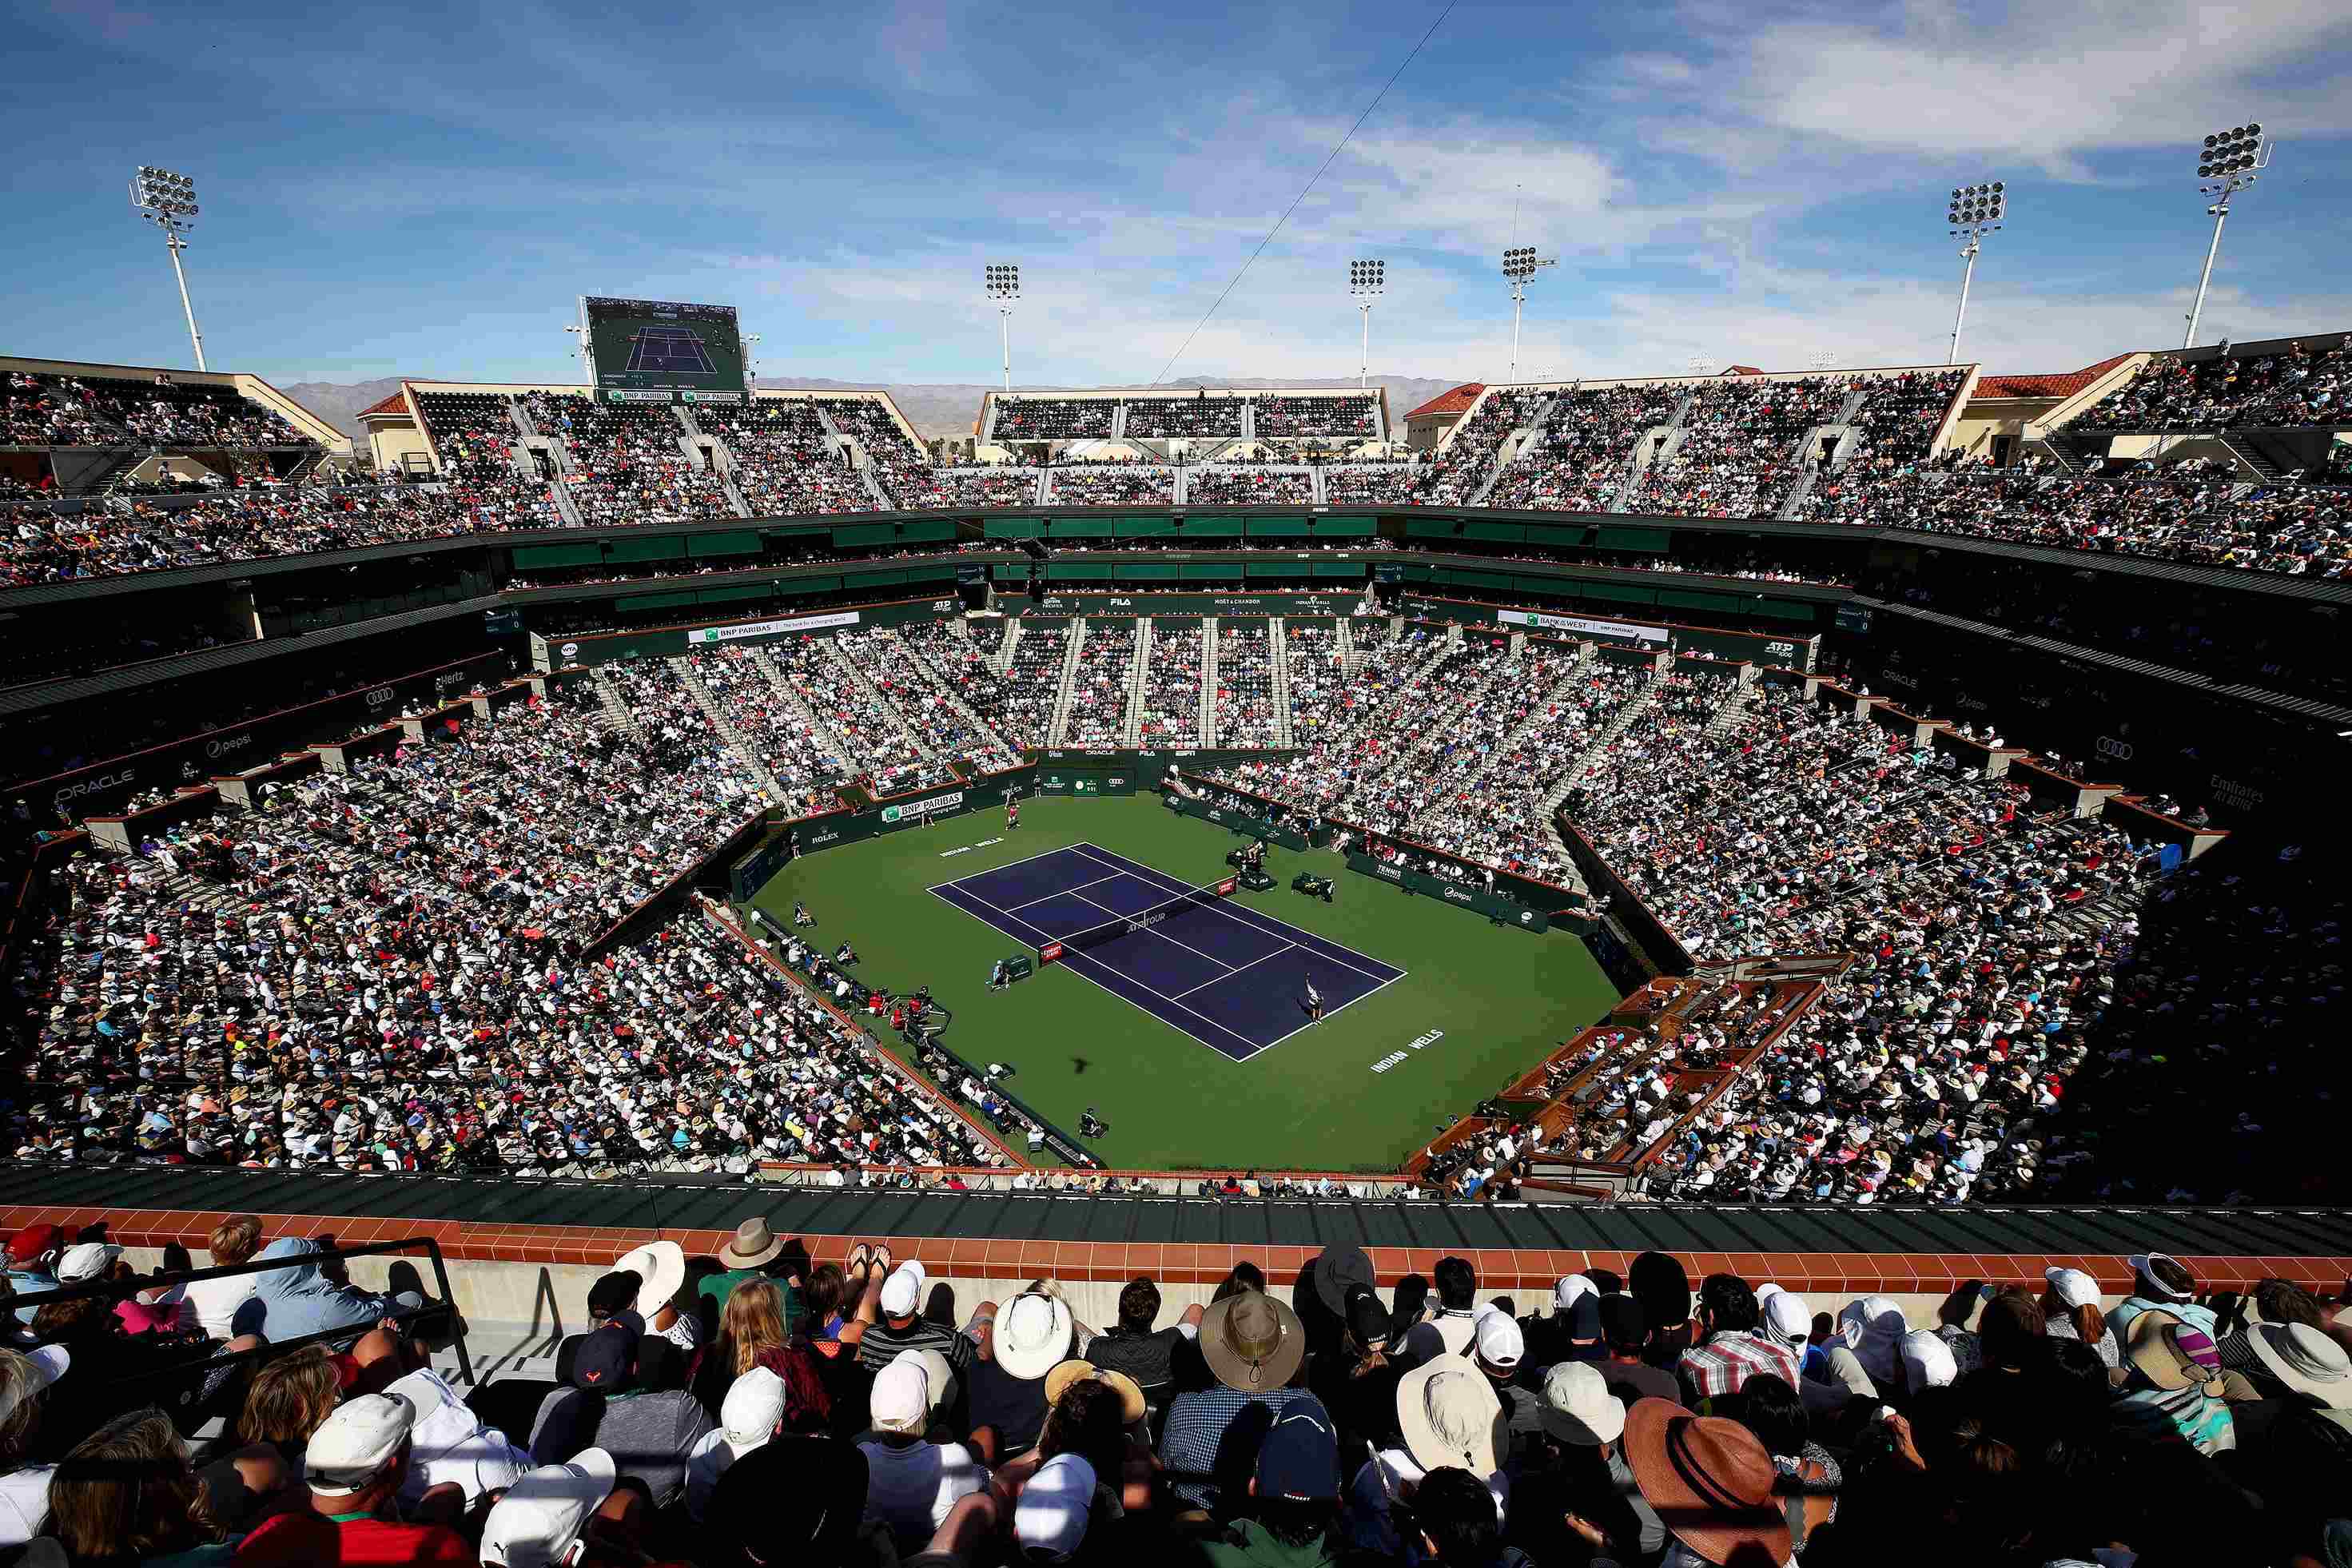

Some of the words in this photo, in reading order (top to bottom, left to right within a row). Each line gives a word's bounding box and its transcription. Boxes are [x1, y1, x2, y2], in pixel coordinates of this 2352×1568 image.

[720, 627, 737, 637] BNP
[739, 625, 772, 635] PARIBAS
[440, 671, 466, 685] Hertz
[1881, 669, 1918, 689] ORACLE
[223, 734, 252, 752] pepsi
[55, 768, 136, 801] ORACLE
[901, 804, 921, 815] BNP
[923, 794, 960, 810] PARIBAS
[812, 831, 839, 845] ROLEX
[1378, 864, 1401, 878] TENNIS
[1453, 891, 1472, 901] pepsi
[1146, 912, 1166, 928] TOUR
[1370, 1049, 1409, 1073] INDIAN
[1407, 1029, 1444, 1049] WELLS
